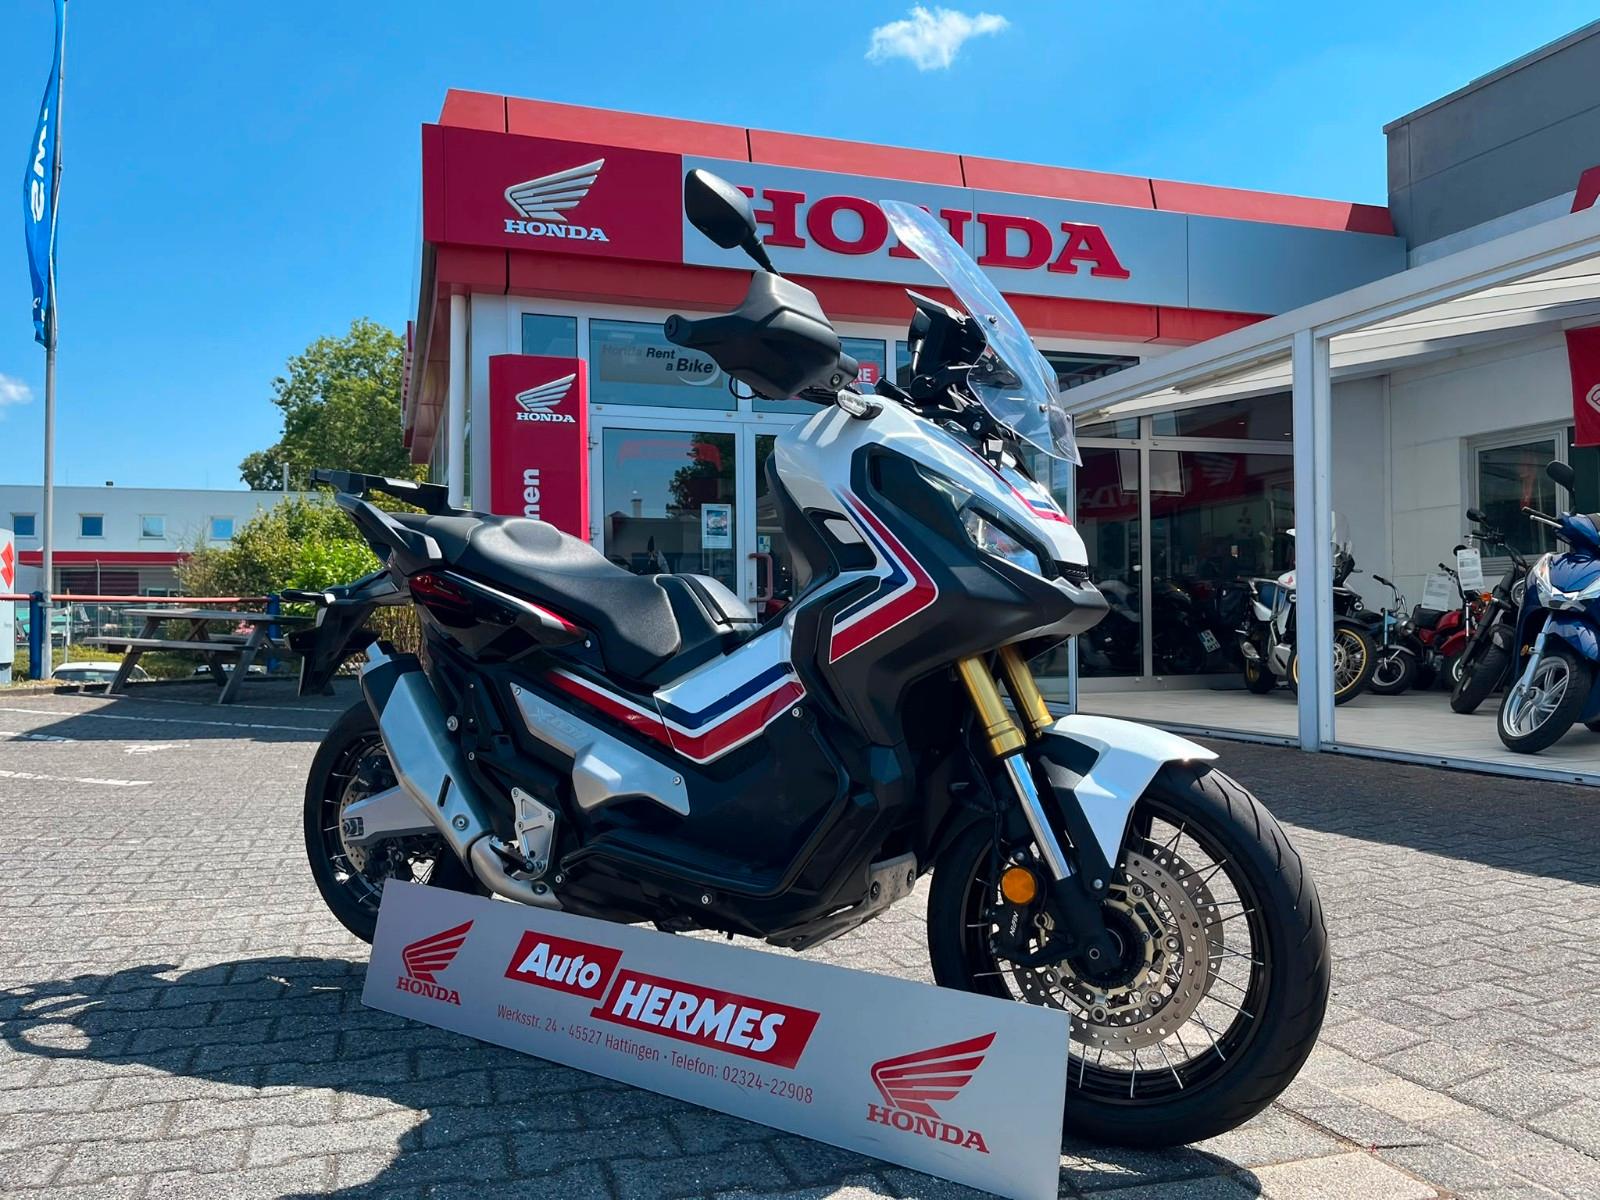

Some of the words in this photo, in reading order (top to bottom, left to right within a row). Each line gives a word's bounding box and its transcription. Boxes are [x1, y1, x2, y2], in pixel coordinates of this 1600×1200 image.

[503, 218, 610, 242] HONDA
[646, 347, 676, 359] Rent
[665, 362, 674, 372] a
[676, 358, 714, 374] Bike
[516, 412, 576, 423] HONDA
[516, 942, 602, 989] Auto
[396, 976, 462, 1006] HONDA
[612, 980, 786, 1053] HERMES
[497, 1004, 541, 1029] Werksstr.
[544, 1017, 558, 1033] 24
[568, 1023, 602, 1045] 45527
[605, 1033, 660, 1061] Hattingen
[671, 1050, 719, 1078] Telefon:
[722, 1065, 813, 1104] 02324-22908
[866, 1103, 990, 1154] HONDA
